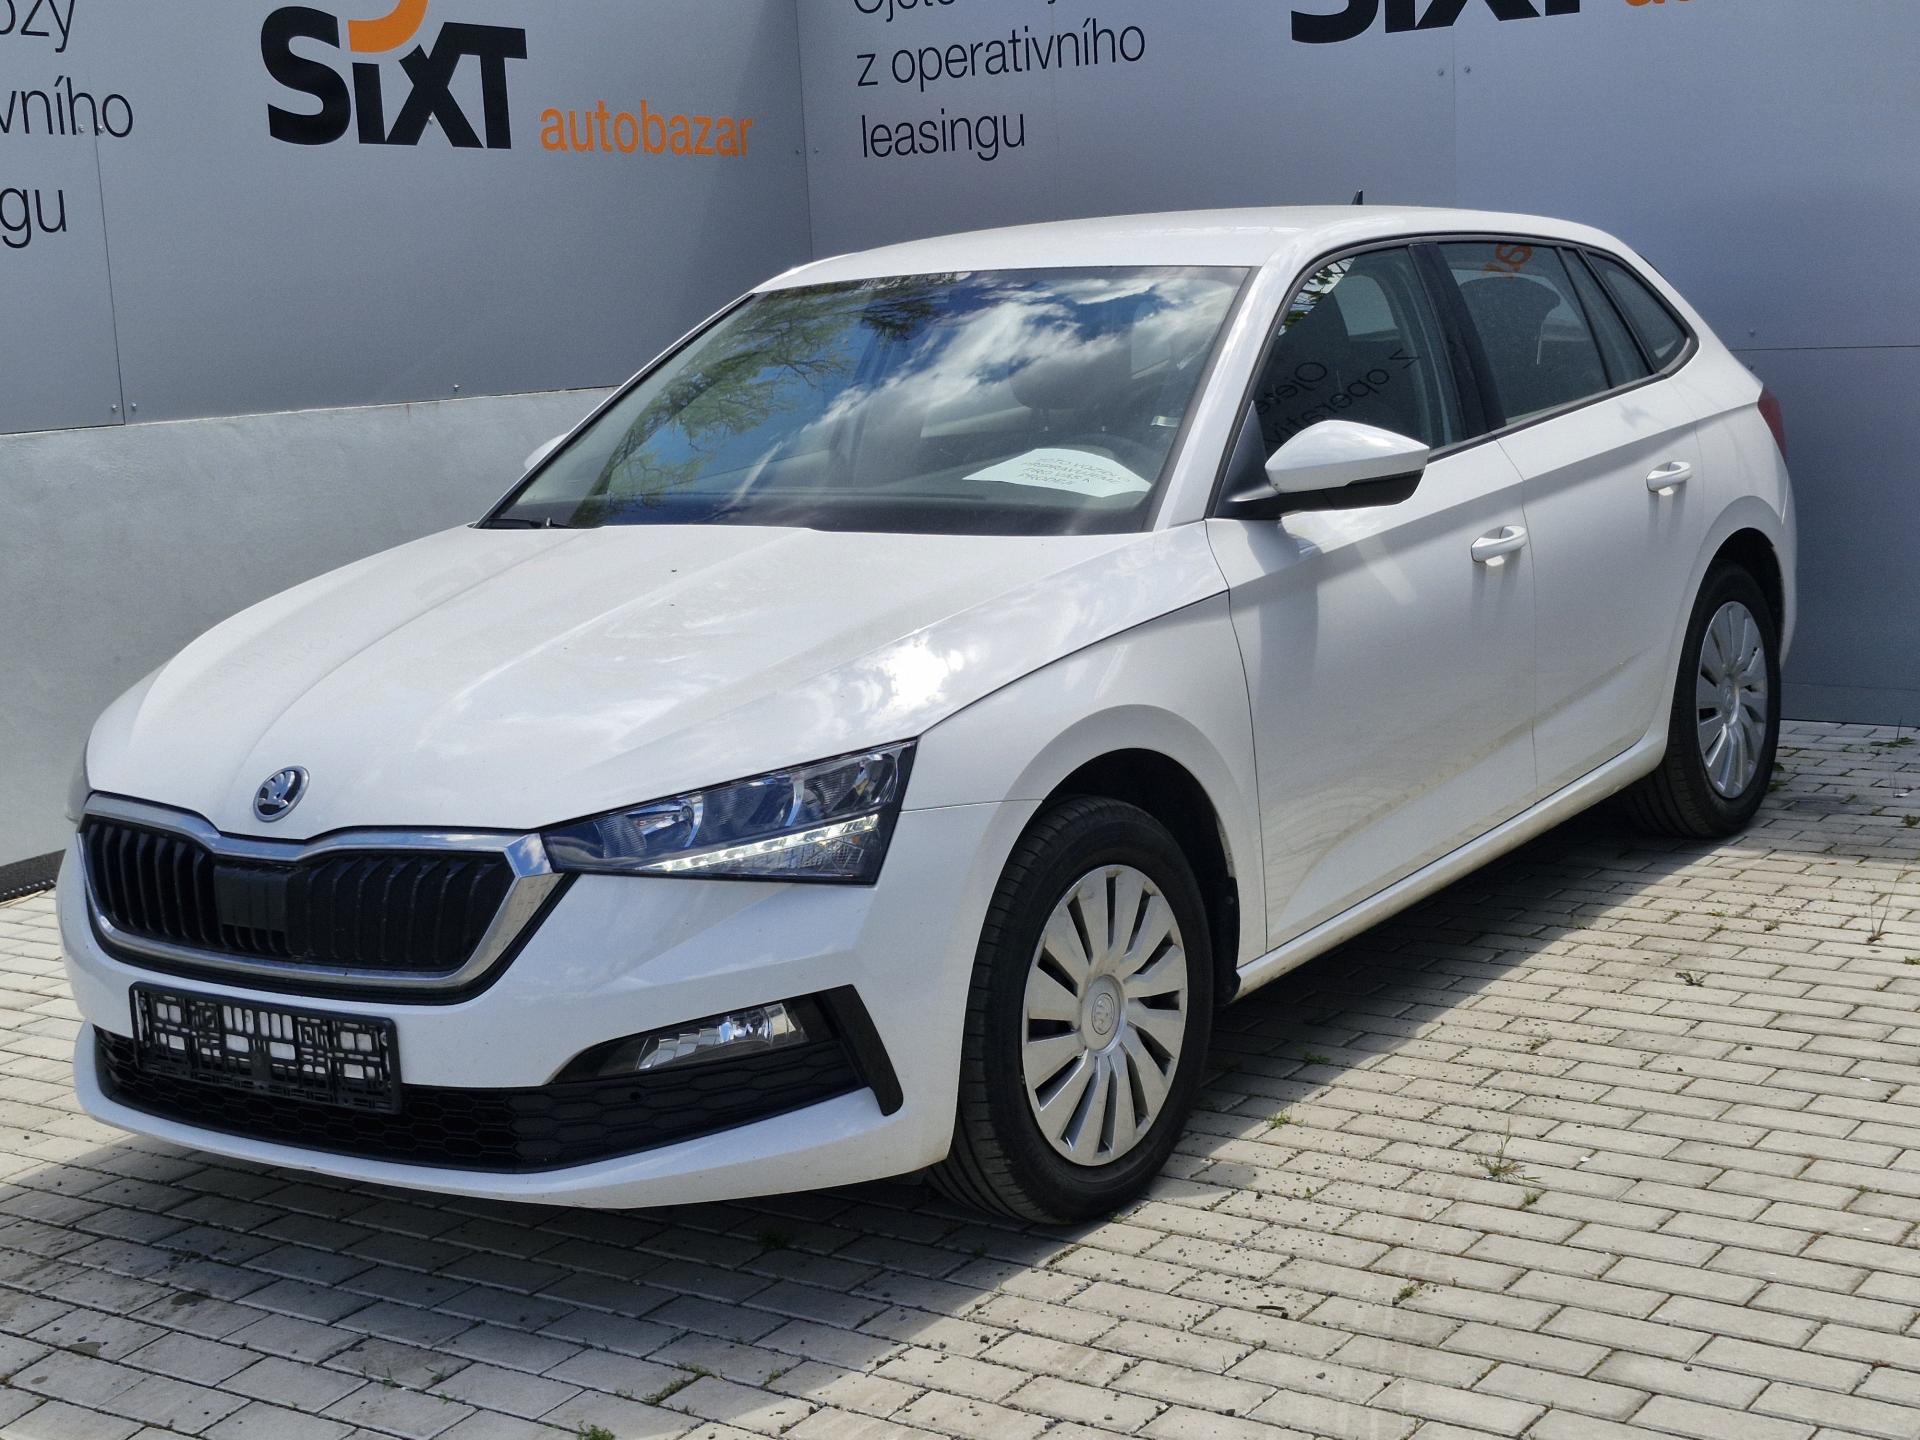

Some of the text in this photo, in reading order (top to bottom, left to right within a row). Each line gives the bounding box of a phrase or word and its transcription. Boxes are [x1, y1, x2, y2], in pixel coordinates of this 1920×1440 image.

[857, 17, 1146, 93] z operativního
[540, 97, 753, 157] autobazar
[861, 108, 1026, 162] leasingu
